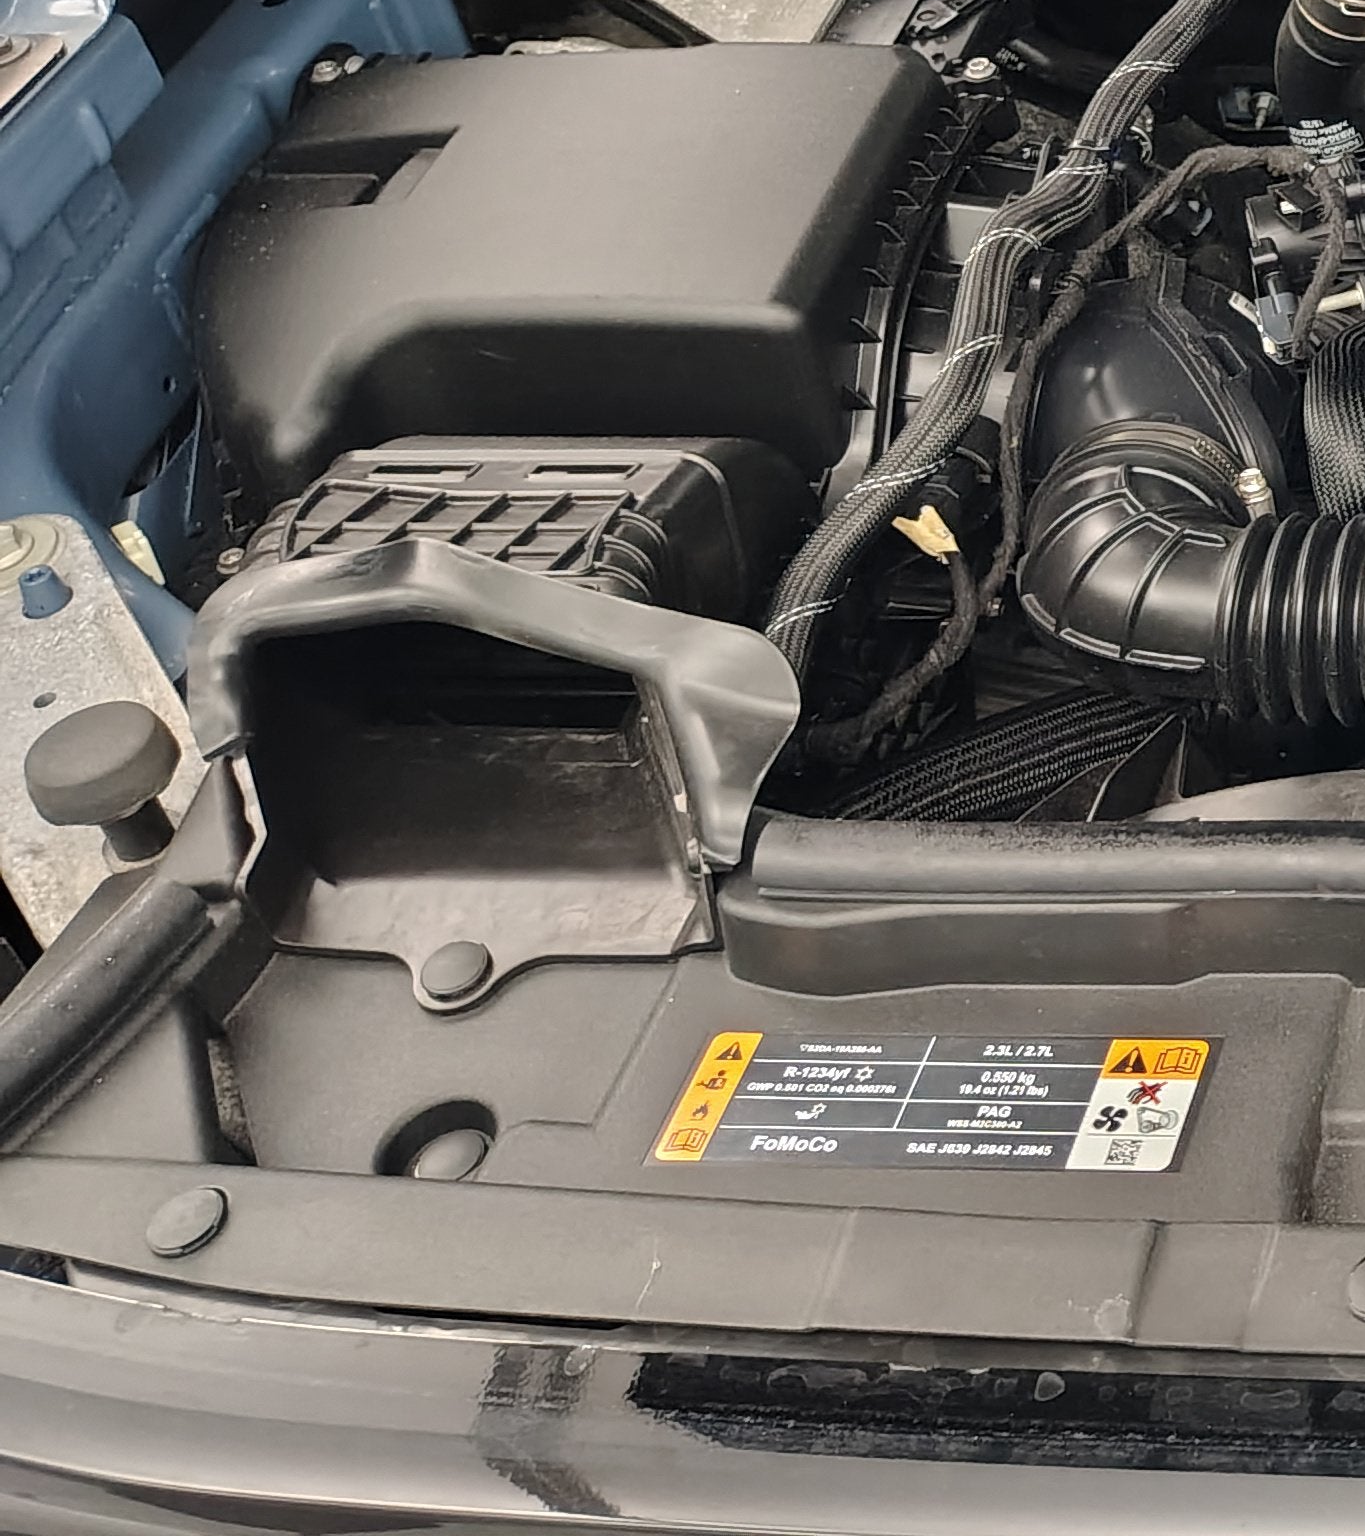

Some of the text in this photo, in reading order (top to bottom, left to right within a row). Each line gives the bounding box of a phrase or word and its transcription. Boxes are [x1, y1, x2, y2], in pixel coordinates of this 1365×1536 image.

[982, 1044, 1014, 1057] 2.3L
[1023, 1045, 1054, 1057] 2.7L
[782, 1066, 852, 1082] R-1234yf
[980, 1070, 1037, 1086] 0.550 kg
[976, 1104, 1013, 1118] PAG
[749, 1134, 838, 1153] FoMoCo
[906, 1142, 938, 1154] SAE
